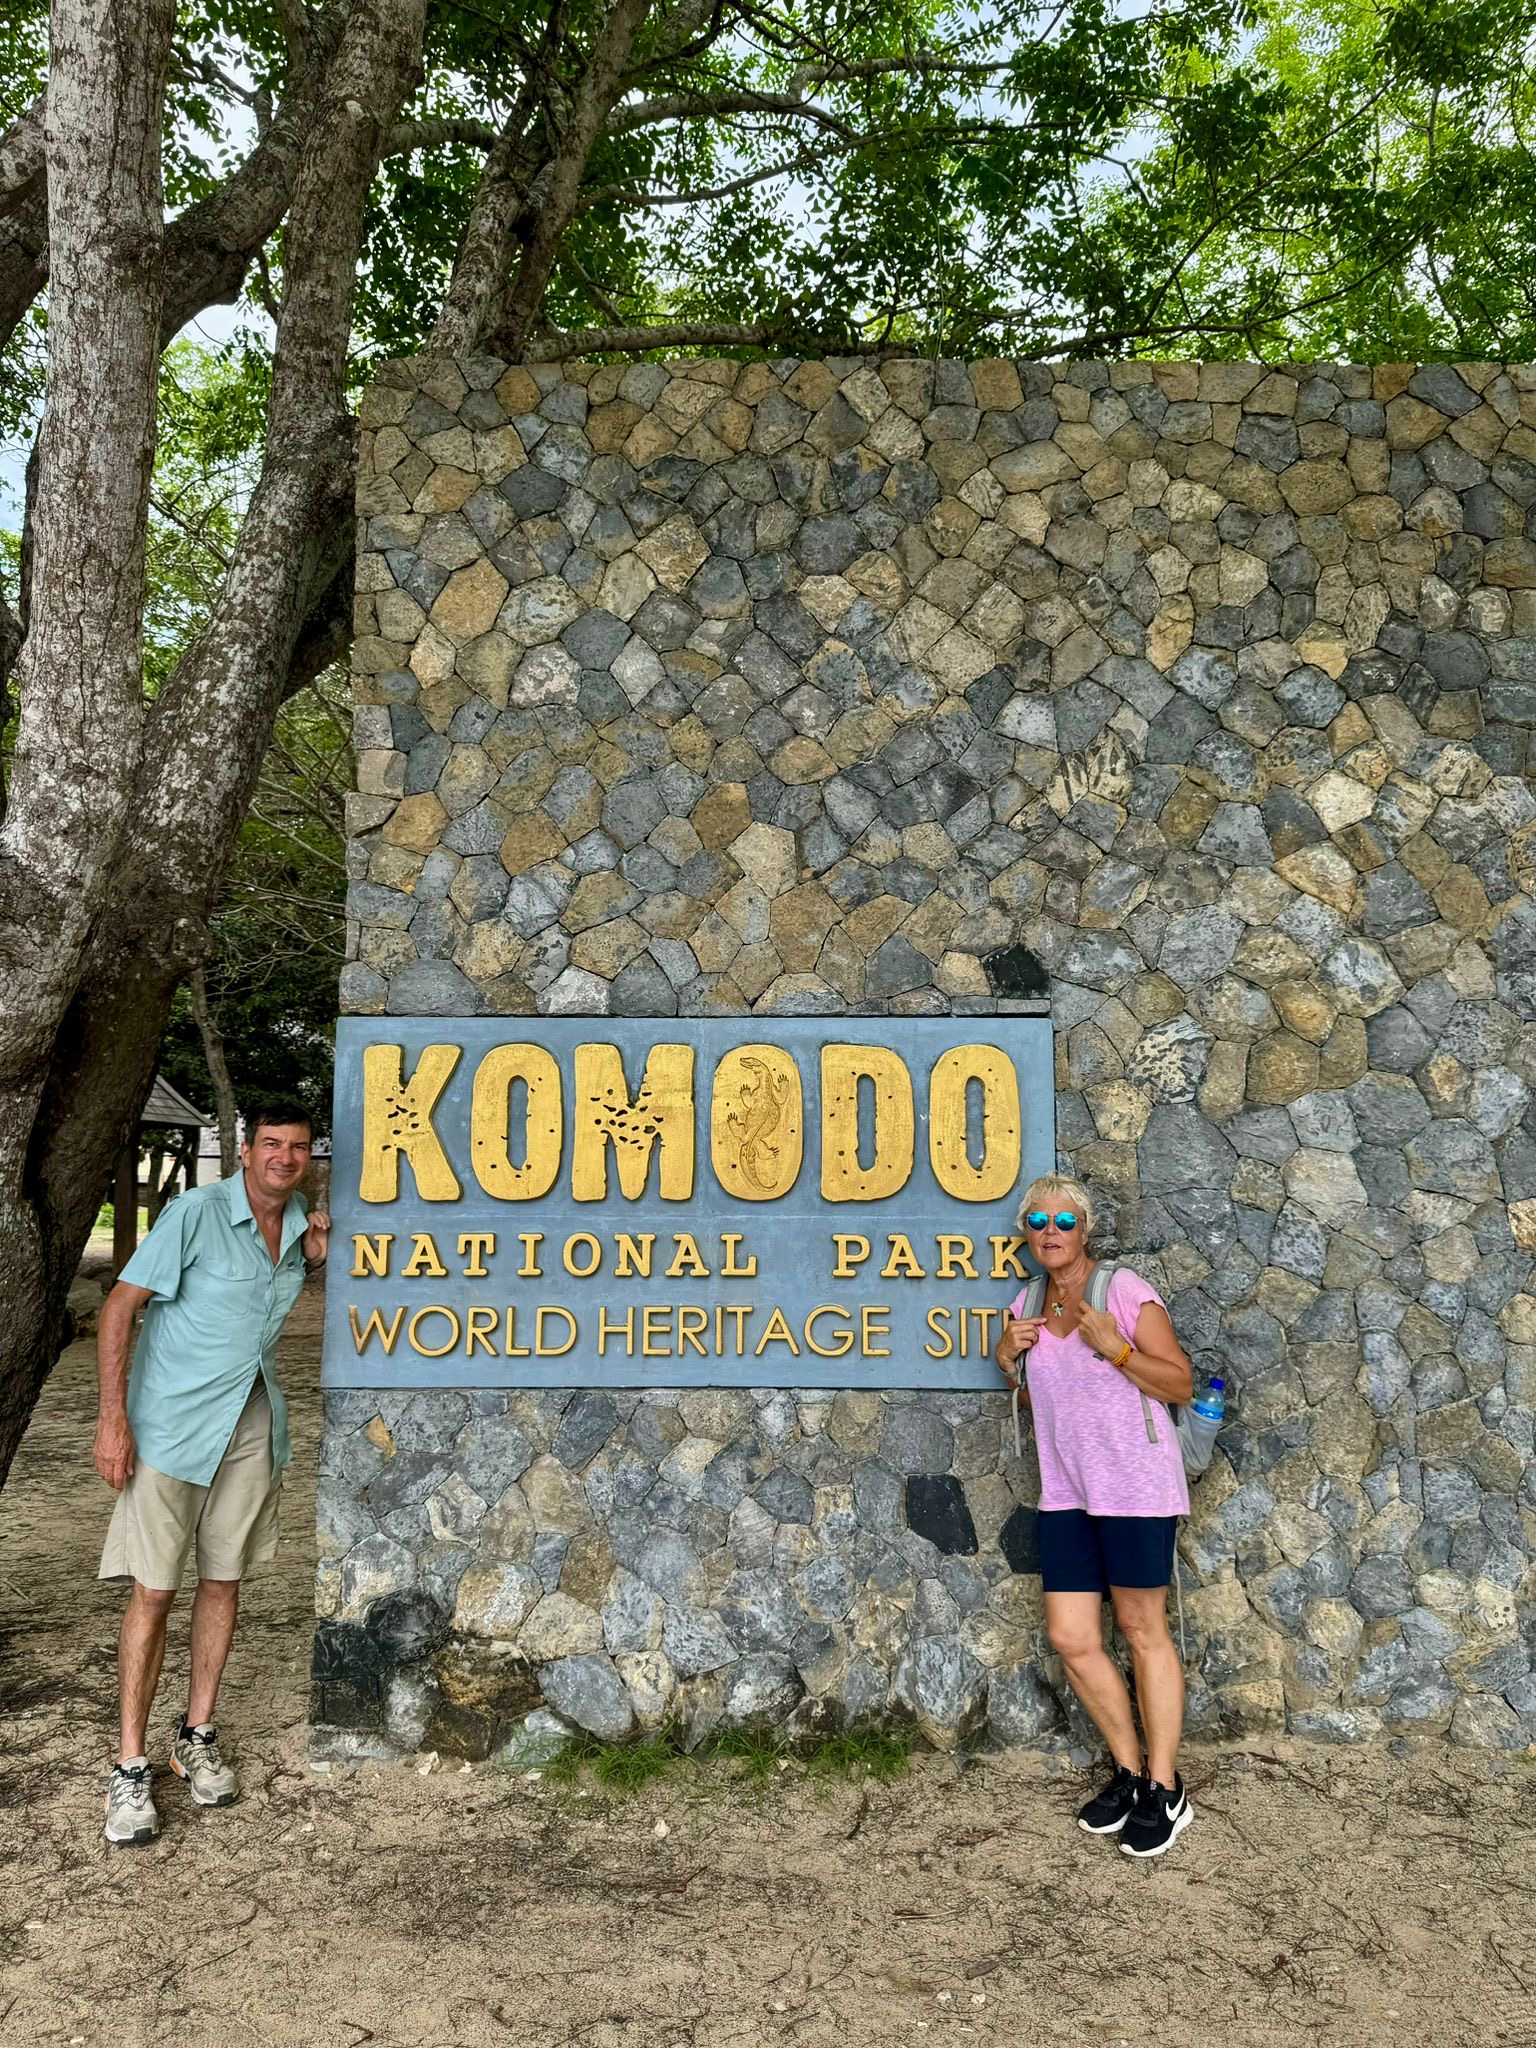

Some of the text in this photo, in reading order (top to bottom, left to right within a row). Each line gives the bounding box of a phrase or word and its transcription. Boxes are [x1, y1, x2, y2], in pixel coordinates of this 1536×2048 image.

[359, 1043, 1021, 1203] KOMODO
[350, 1233, 1032, 1279] NATIONAL PARK
[349, 1305, 578, 1357] WORLD
[598, 1305, 891, 1357] HERITAGE
